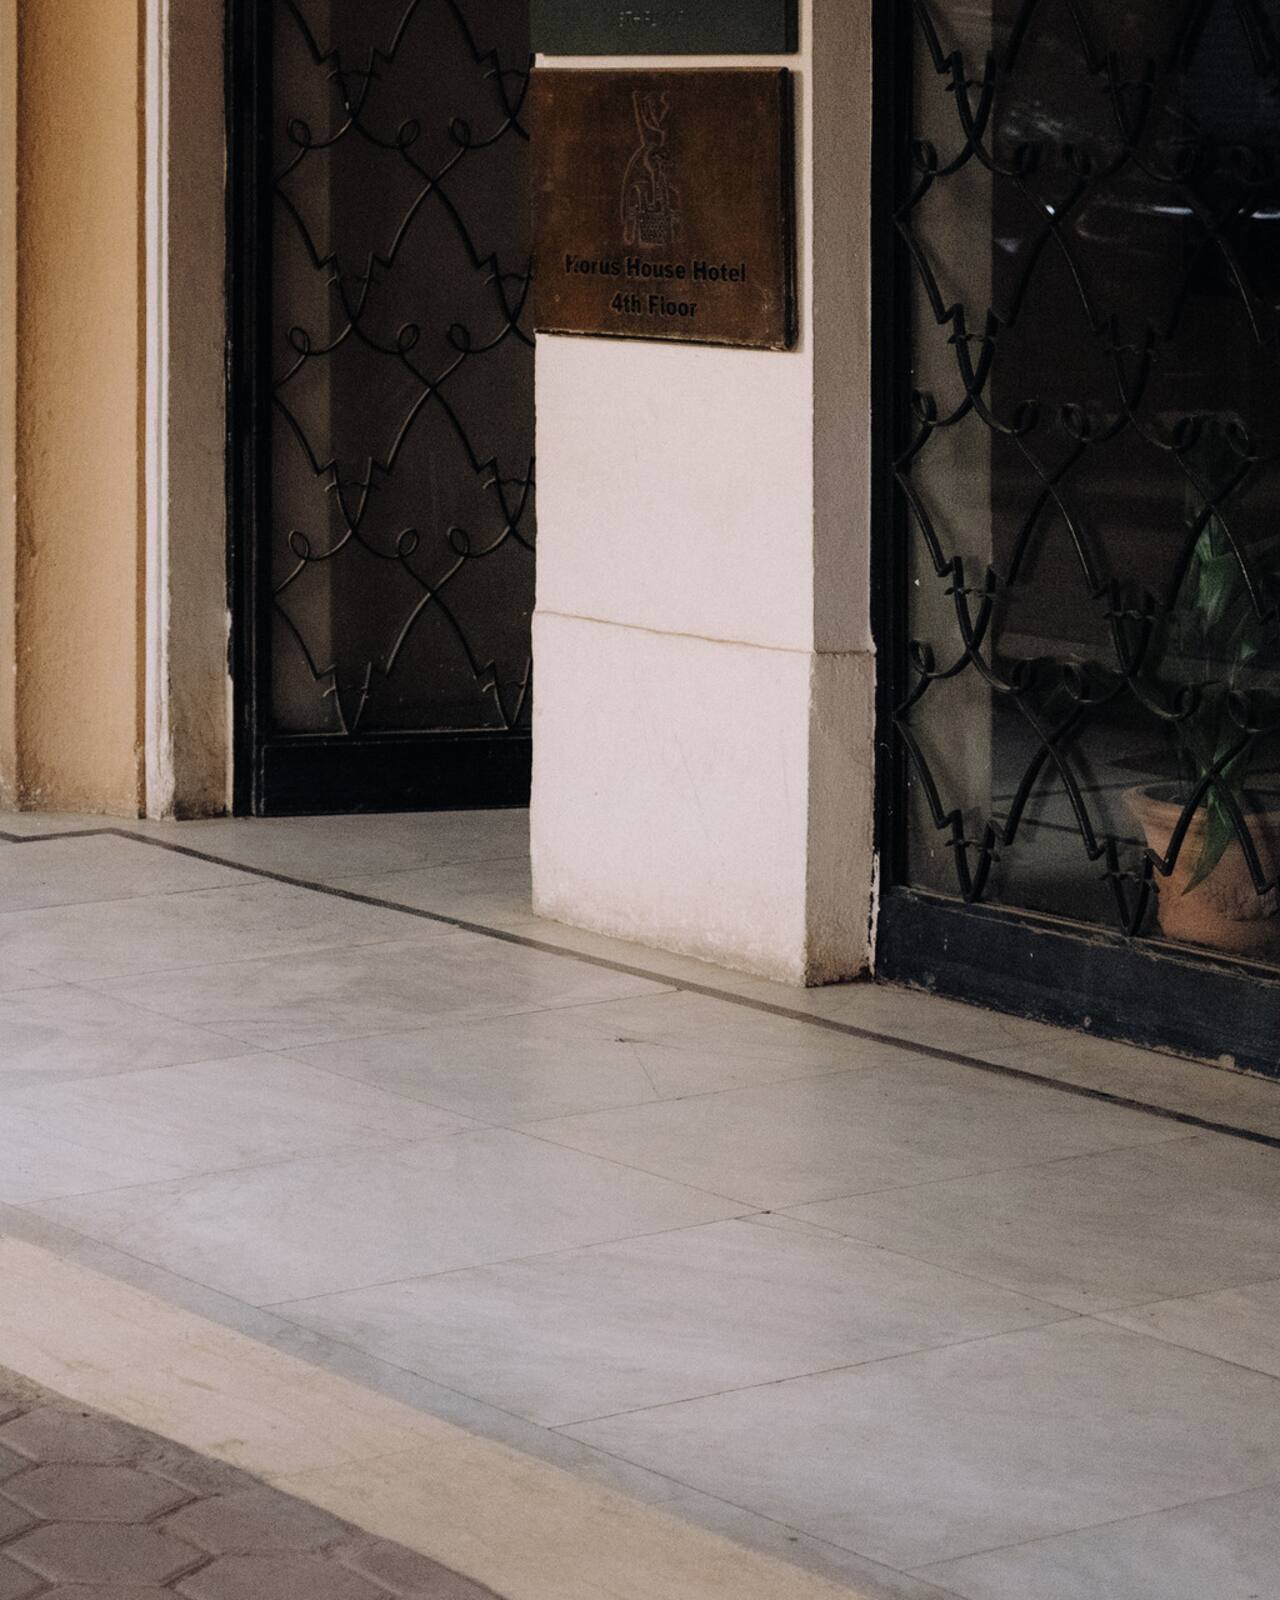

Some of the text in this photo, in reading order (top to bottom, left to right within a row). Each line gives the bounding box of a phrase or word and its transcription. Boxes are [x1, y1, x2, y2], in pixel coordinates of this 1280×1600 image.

[565, 254, 746, 283] Horus House Hotel
[611, 292, 698, 318] 4th Floor
